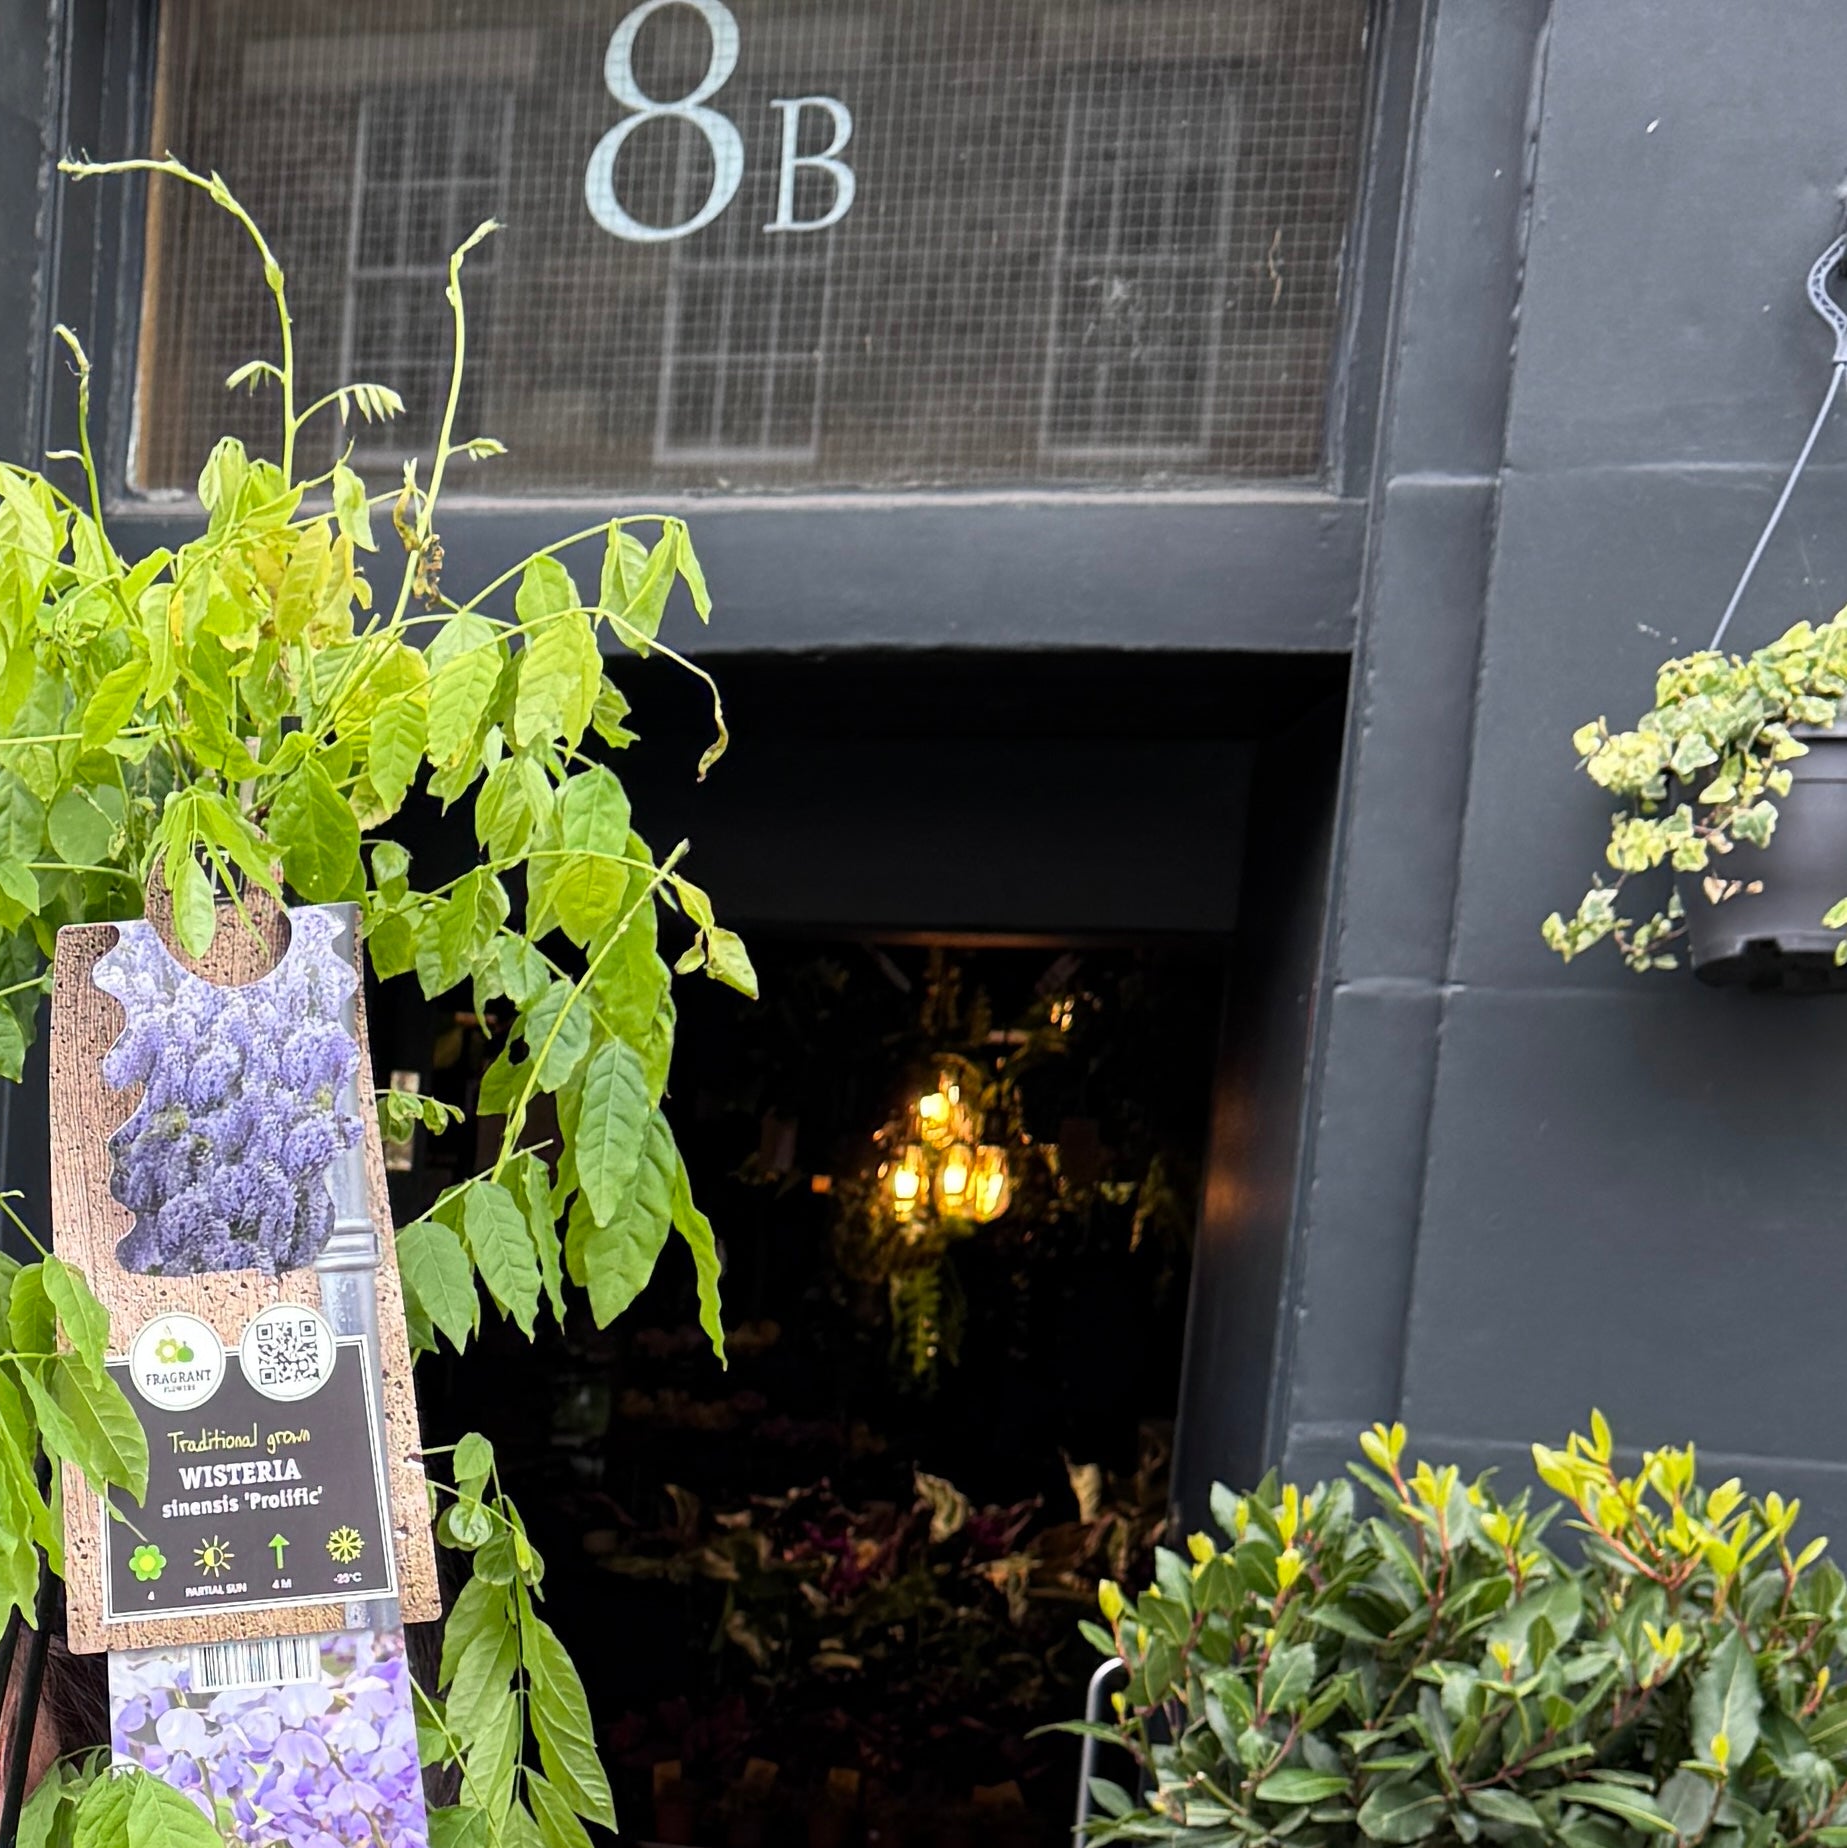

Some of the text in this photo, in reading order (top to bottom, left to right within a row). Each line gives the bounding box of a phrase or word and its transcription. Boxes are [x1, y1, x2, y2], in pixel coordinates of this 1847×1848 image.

[146, 1369, 212, 1386] FRAGRANT
[167, 1422, 311, 1454] Traditional grown
[179, 1458, 302, 1490] WISTERIA
[162, 1486, 323, 1518] sinensis 'Prolific'
[185, 1582, 248, 1597] PARTIAL SUN
